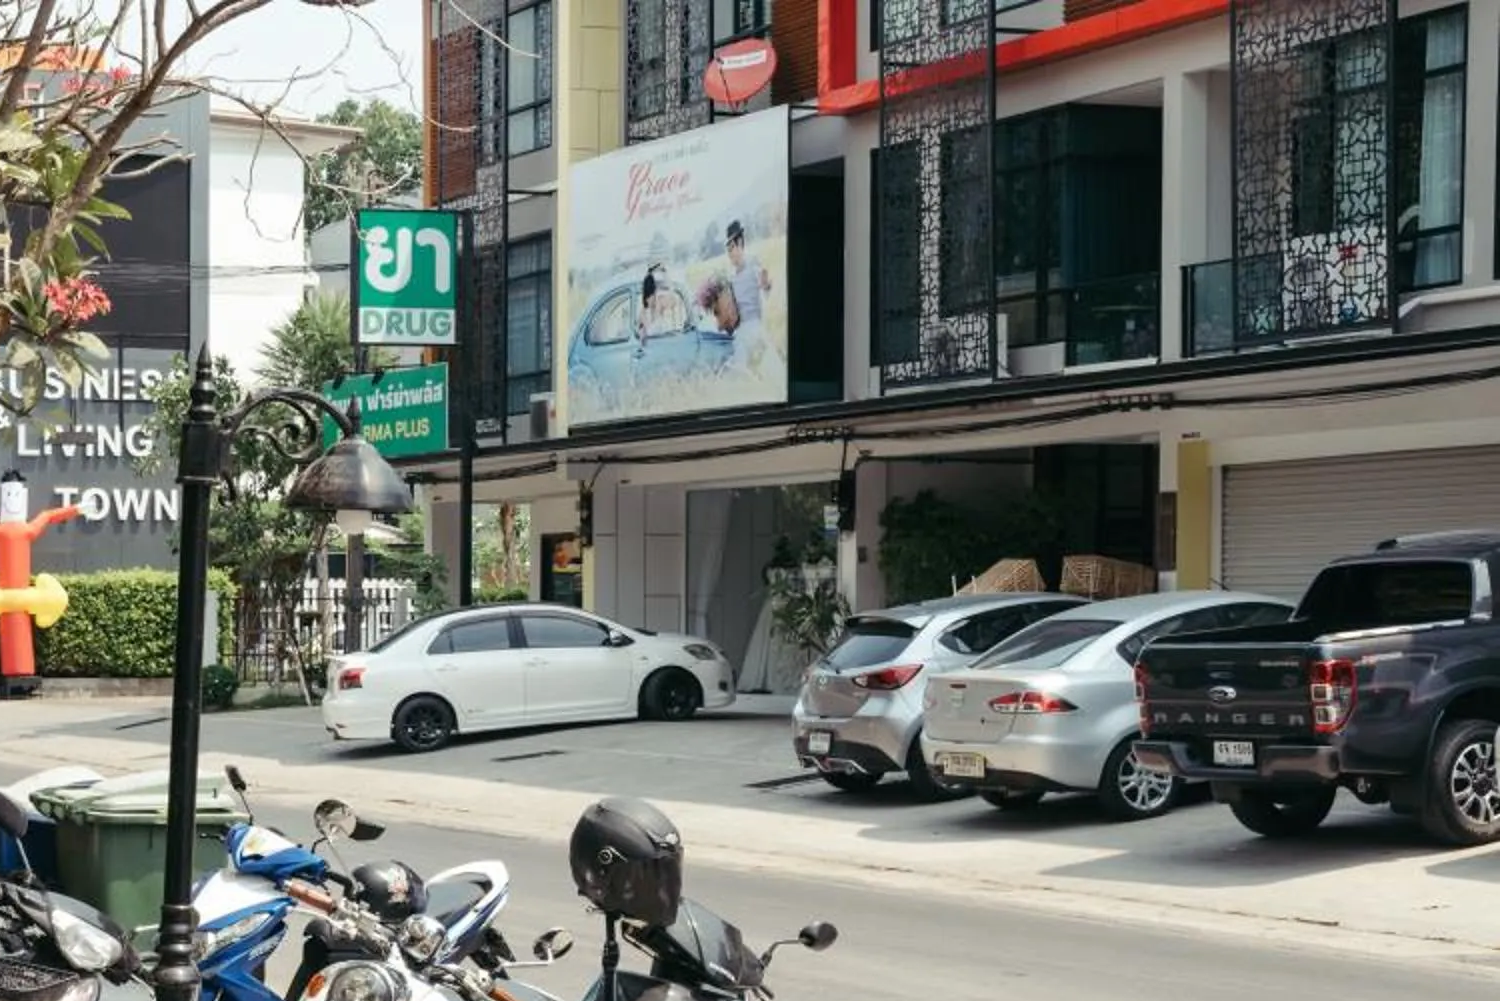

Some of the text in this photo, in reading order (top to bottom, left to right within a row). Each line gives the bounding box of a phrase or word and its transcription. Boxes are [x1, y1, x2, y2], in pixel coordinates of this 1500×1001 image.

[365, 226, 451, 294] ยา
[362, 311, 451, 337] DRUG
[396, 418, 430, 439] PLUS
[54, 487, 180, 521] TOWN
